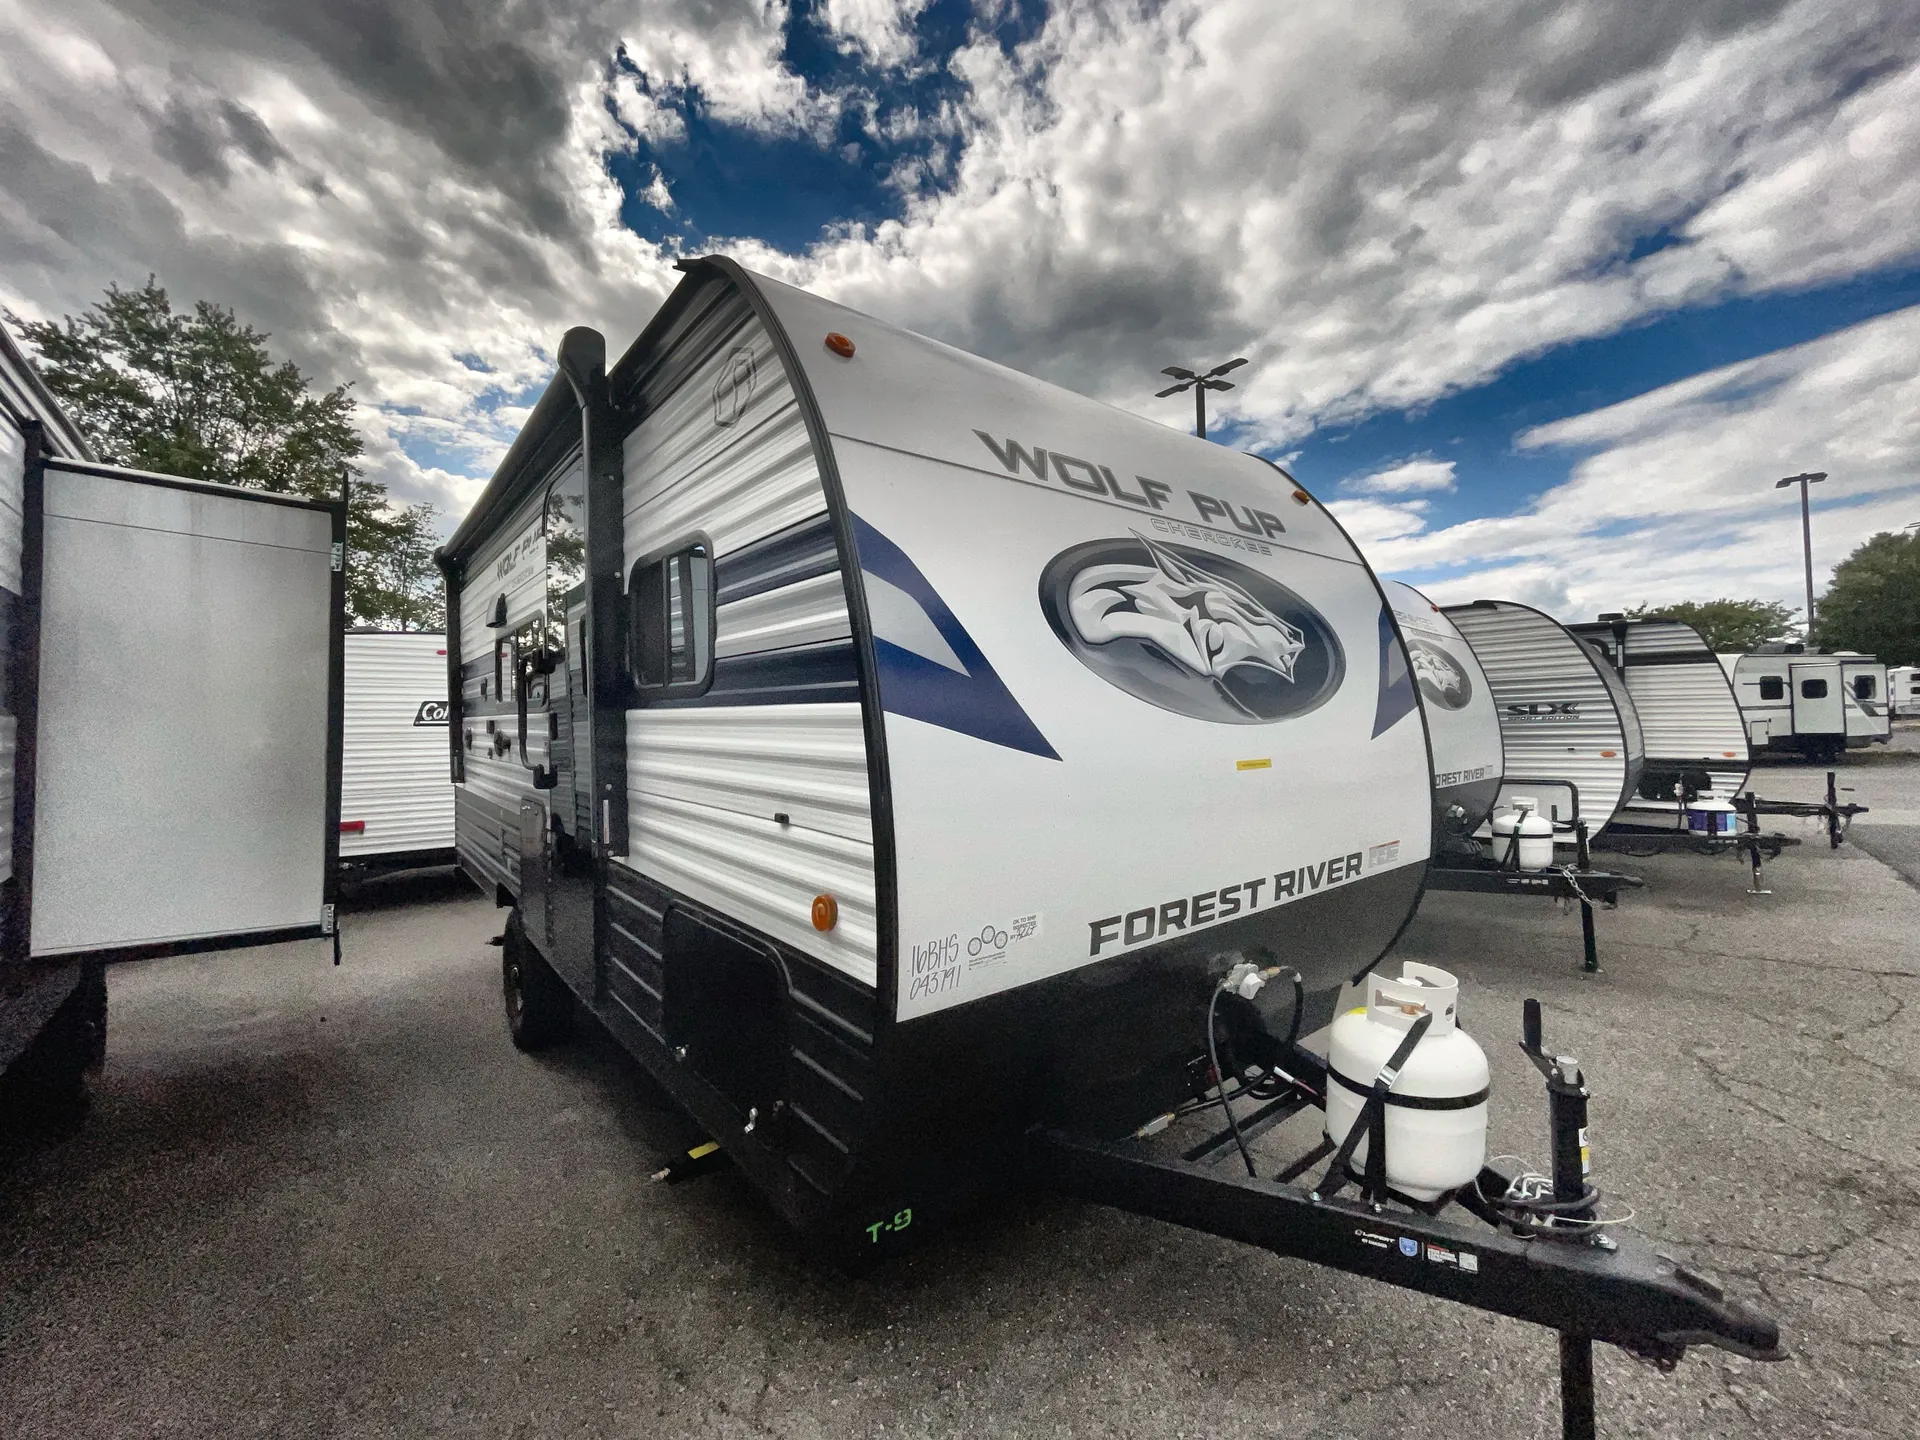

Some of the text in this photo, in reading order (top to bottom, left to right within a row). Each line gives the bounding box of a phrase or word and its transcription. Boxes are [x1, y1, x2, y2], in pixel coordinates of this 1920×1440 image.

[971, 428, 1287, 539] WOLF PUP
[1150, 517, 1273, 557] CHEROKEE
[1507, 702, 1580, 716] SLX
[1435, 767, 1485, 787] OREST RIVER
[1088, 879, 1266, 957] FOREST
[1274, 852, 1363, 902] RIVER
[911, 933, 959, 977] 16BHS
